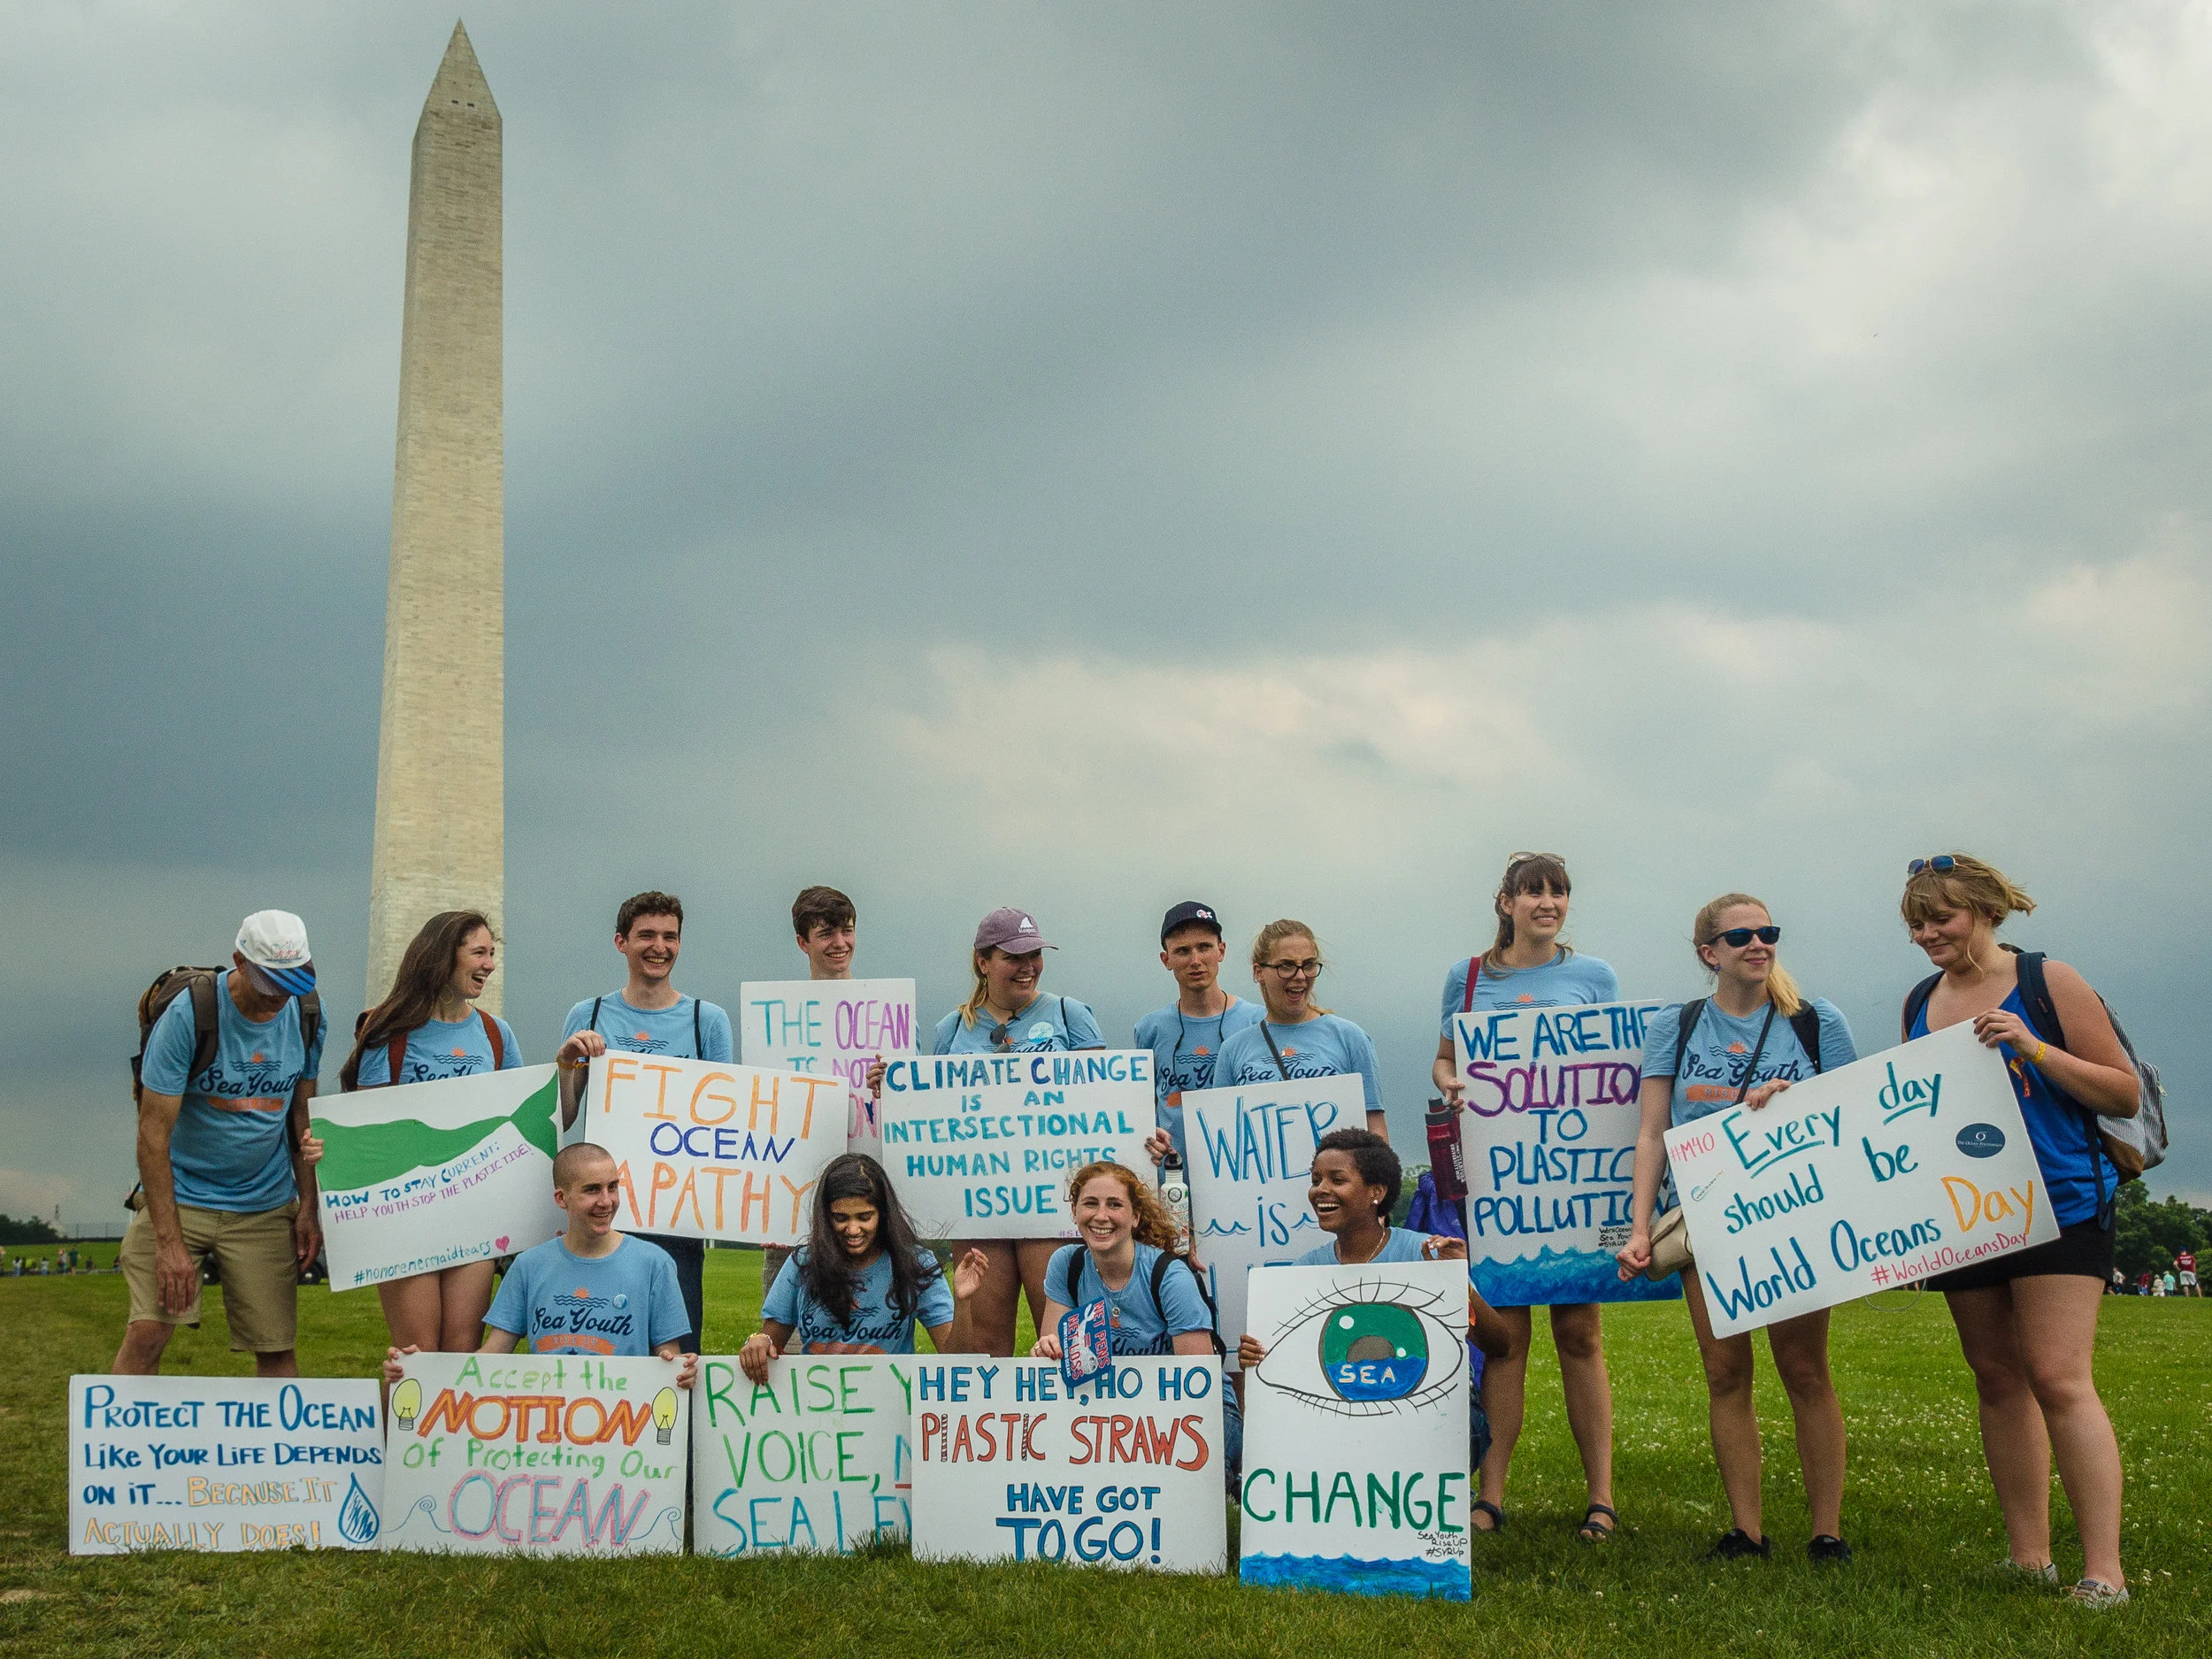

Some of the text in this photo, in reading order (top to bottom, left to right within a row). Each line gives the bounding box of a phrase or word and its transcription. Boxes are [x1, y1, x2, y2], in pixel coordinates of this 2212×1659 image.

[750, 999, 910, 1050] THE OCEAN
[1458, 1012, 1520, 1061] WE
[198, 1065, 245, 1095] Sea
[886, 1055, 1148, 1093] CLIMATE CHANGE
[1237, 1064, 1276, 1087] Sea
[1466, 1061, 1641, 1118] SOLUTIO
[1682, 1053, 1803, 1087] Sea Youth
[604, 1057, 840, 1141] FIGHT
[961, 1090, 1065, 1113] IS AN
[1722, 1062, 1942, 1170] Every day
[649, 1122, 795, 1164] OCEAN
[884, 1110, 1135, 1144] INTERSECTIONAL
[1528, 1109, 1587, 1145] TO
[326, 1141, 500, 1209] HOW TO STAY CURRENT:
[334, 1142, 534, 1224] HELP YOUTH STOP THE PLASTIC TIDE!
[907, 1147, 1117, 1178] HUMAN RIGHTS
[1489, 1141, 1635, 1192] PLASTIC
[617, 1159, 815, 1235] APATHY
[964, 1184, 1058, 1218] ISSUE
[1724, 1163, 1824, 1234] should
[1863, 1137, 1918, 1182] be
[353, 1240, 491, 1286] #nomoremermaidtears
[1706, 1176, 2033, 1321] World Oceans Day
[1870, 1233, 2028, 1286] #WorldOceansDay
[532, 1307, 634, 1336] Sea Youth
[799, 1313, 837, 1338] Sea
[1094, 1300, 1105, 1327] NET
[1067, 1314, 1084, 1379] NET LOSS
[455, 1356, 627, 1393] Accept the
[706, 1362, 875, 1427] RAISE
[919, 1365, 999, 1402] HEY
[1095, 1365, 1142, 1400] HO
[1159, 1366, 1211, 1401] HO
[1339, 1364, 1396, 1384] SEA
[85, 1384, 375, 1432] PROTECT THE OCEAN
[417, 1388, 652, 1446] NOTION
[148, 1443, 208, 1469] YOUR
[275, 1442, 382, 1466] DEPENDS
[467, 1438, 605, 1479] Protecting
[620, 1450, 679, 1479] Our
[722, 1430, 880, 1494] VOICE,
[1070, 1415, 1209, 1471] STRAWS
[83, 1485, 115, 1504] ON
[188, 1477, 299, 1507] BECAUSE
[300, 1477, 337, 1502] IT
[447, 1470, 651, 1548] OCEAN
[1007, 1482, 1161, 1515] HAVE GOT
[1242, 1468, 1465, 1532] CHANGE
[84, 1517, 320, 1548] ACTUALLY DOES!
[996, 1517, 1161, 1564] TO GO!
[1417, 1531, 1458, 1540] Sea Youth
